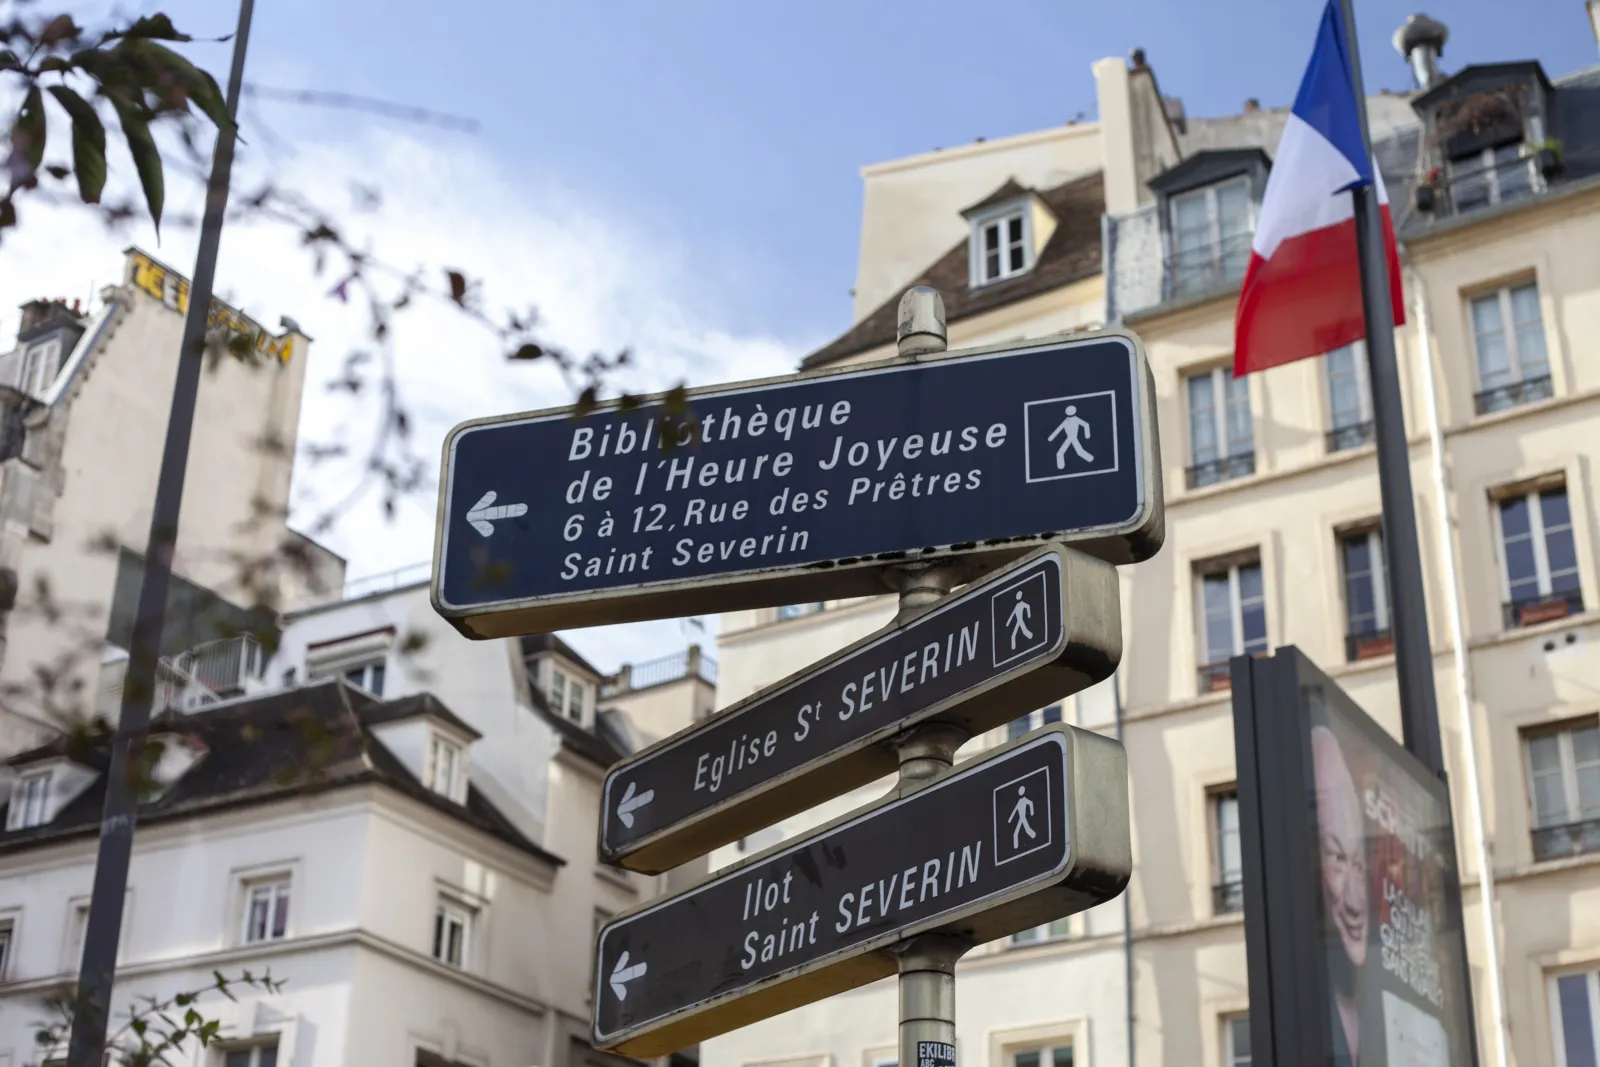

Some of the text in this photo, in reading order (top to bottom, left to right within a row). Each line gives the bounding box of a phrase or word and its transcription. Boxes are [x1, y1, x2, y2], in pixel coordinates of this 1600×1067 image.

[565, 421, 1007, 505] de l'Heure Joyeuse
[563, 514, 586, 542] 6
[597, 509, 614, 539] à
[769, 486, 829, 516] des
[848, 467, 983, 506] Prêtres
[560, 526, 810, 581] Saint Severin
[693, 620, 980, 794] Eglise St SEVERIN
[740, 840, 982, 971] Saint SEVERIN
[742, 869, 793, 921] Ilot
